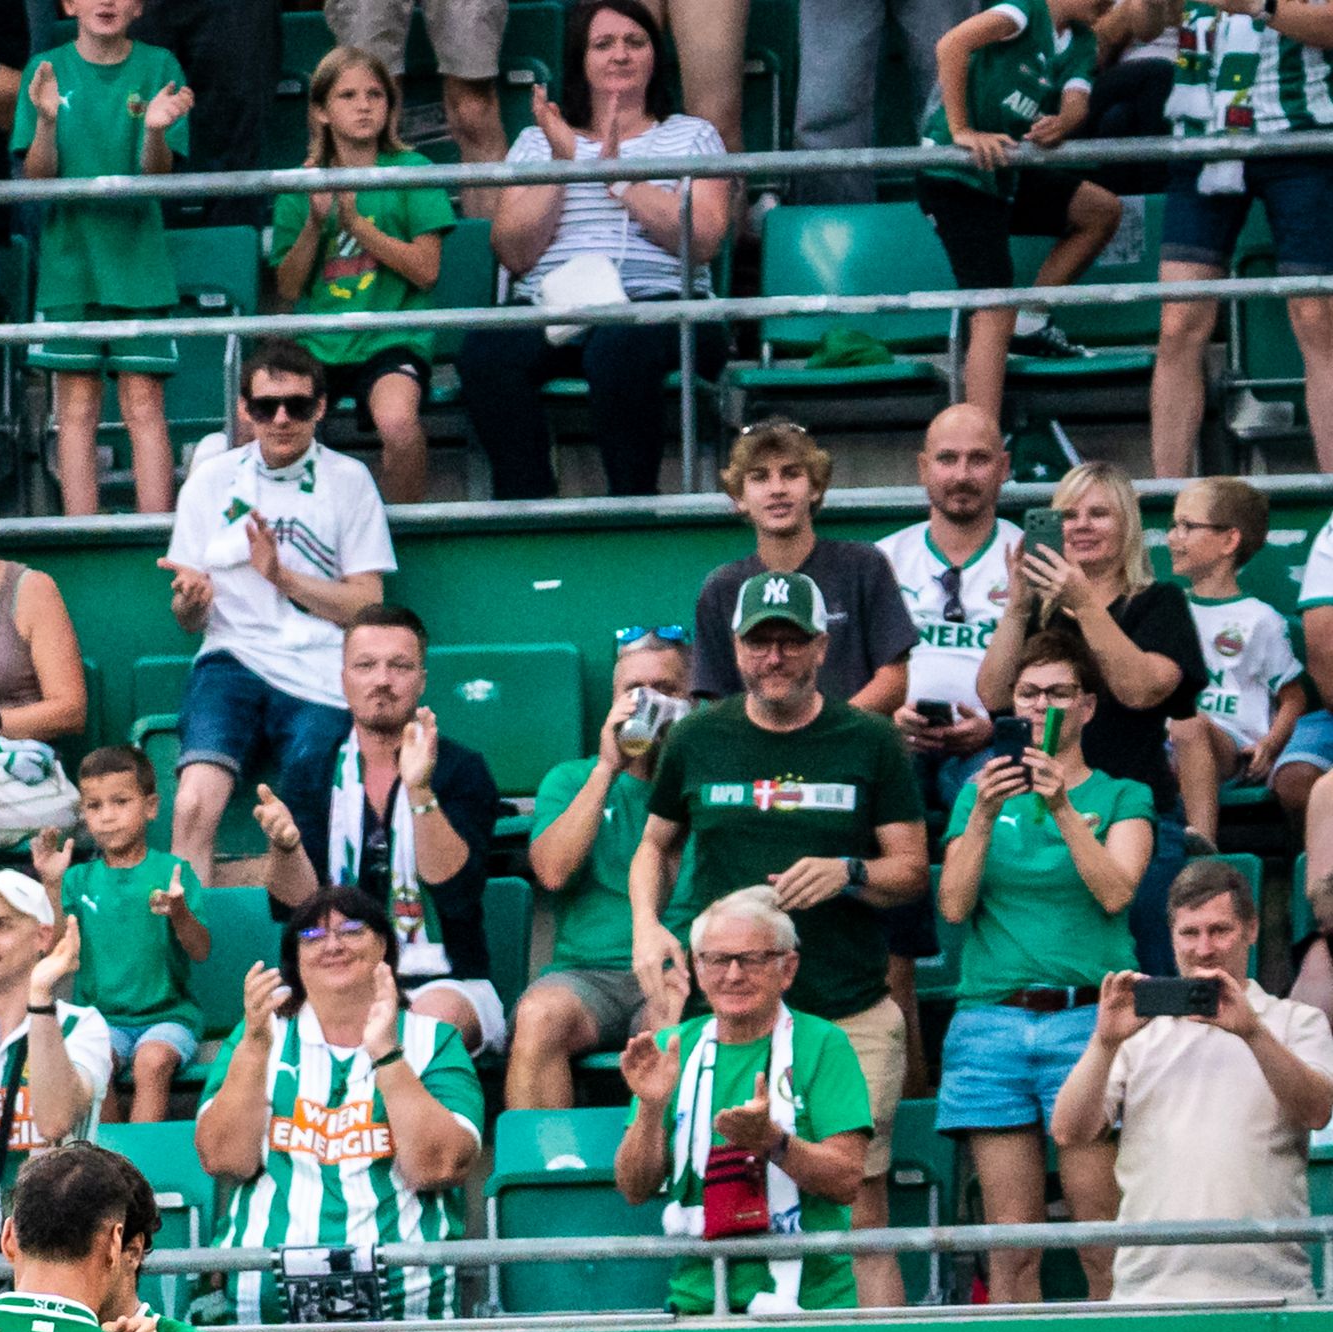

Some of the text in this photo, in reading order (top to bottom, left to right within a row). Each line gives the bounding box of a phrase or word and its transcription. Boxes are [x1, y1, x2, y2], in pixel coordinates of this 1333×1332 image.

[302, 1100, 369, 1137] WIEN
[270, 1120, 392, 1161] ENERGIE
[33, 1299, 67, 1314] SCR
